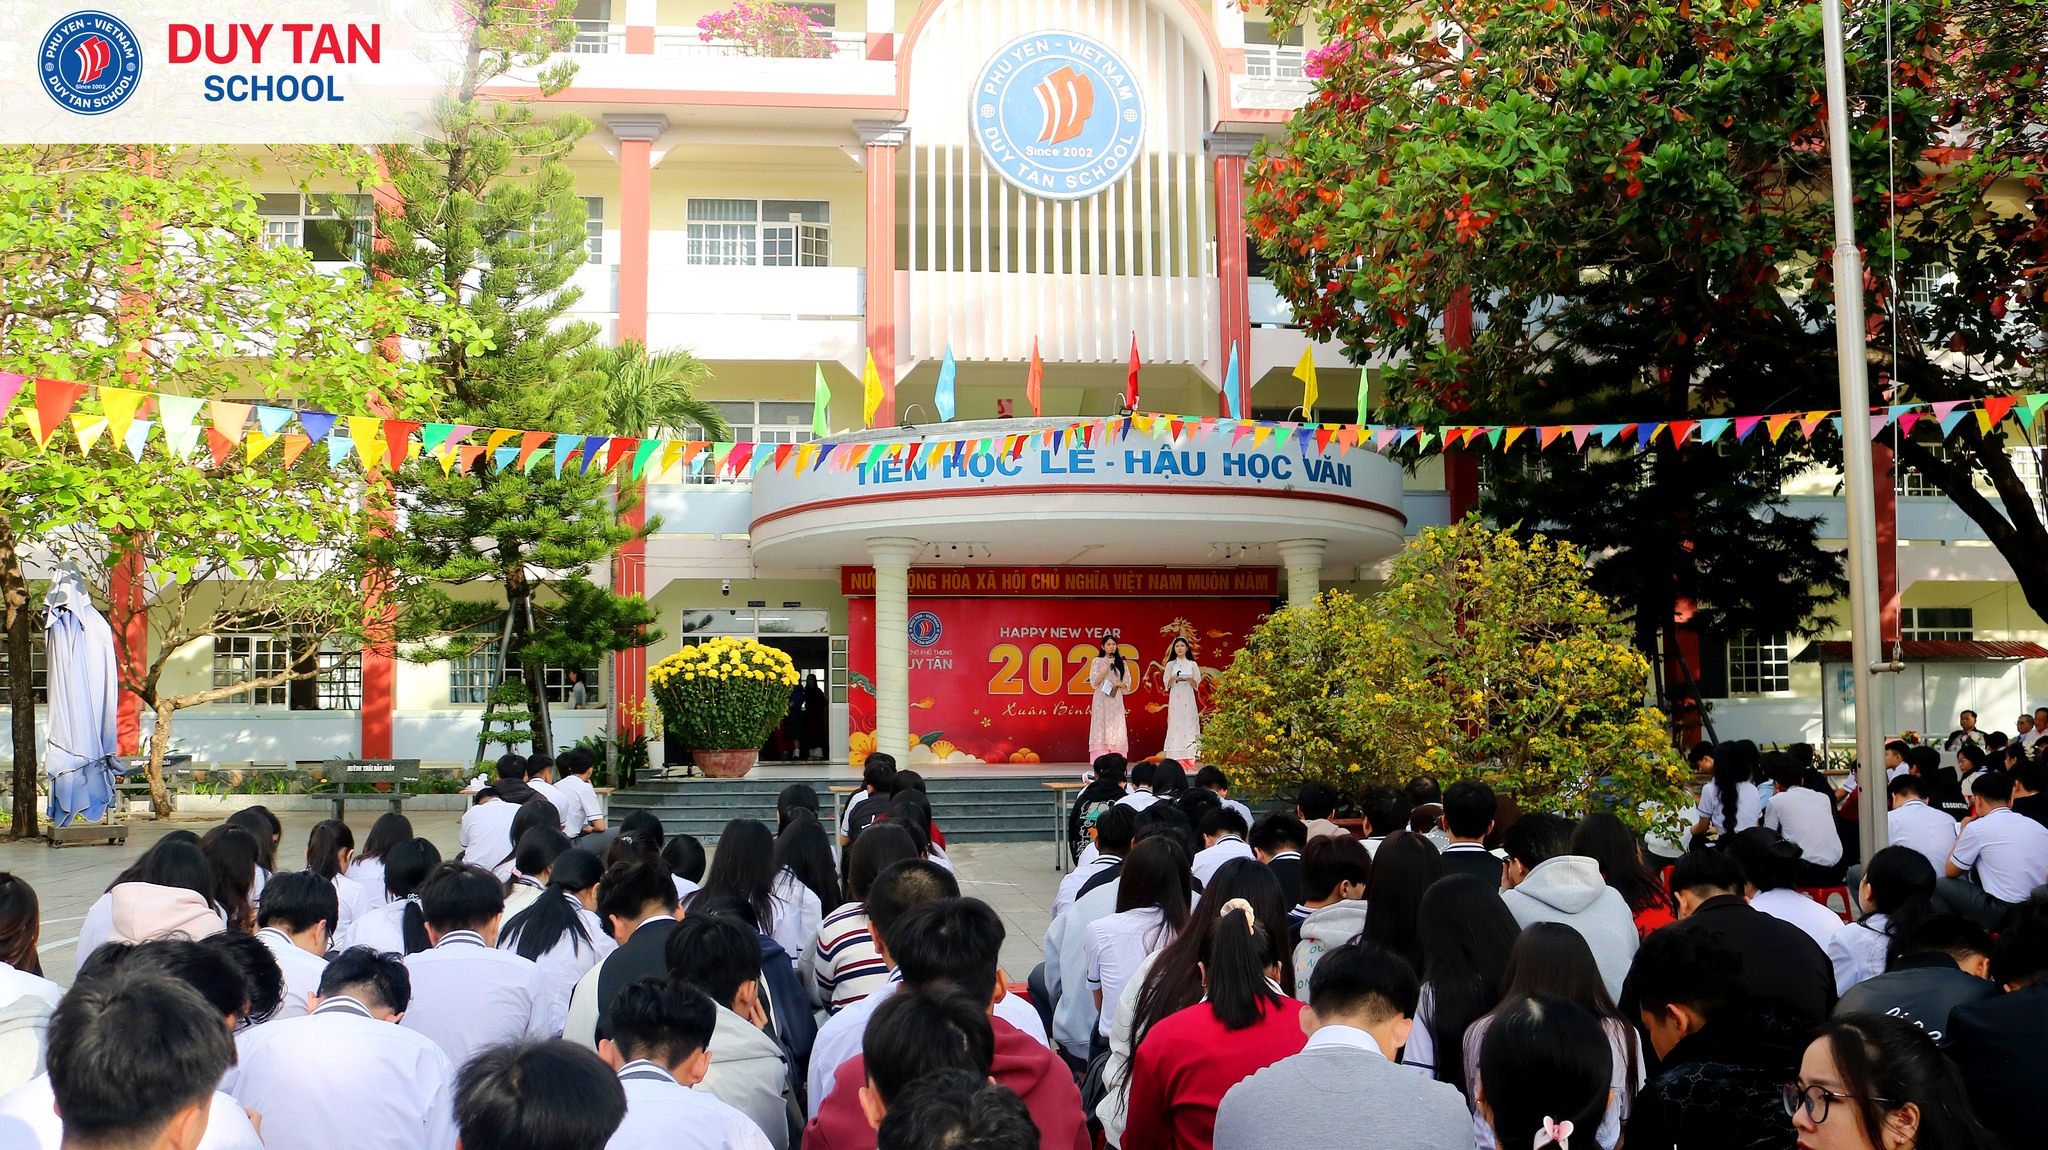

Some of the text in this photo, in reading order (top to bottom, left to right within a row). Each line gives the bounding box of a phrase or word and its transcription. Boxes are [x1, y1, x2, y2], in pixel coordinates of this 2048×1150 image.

[984, 60, 1013, 96] PHU
[1010, 39, 1050, 63] YEN
[984, 126, 1135, 189] DUY TAN SCHOOL
[1025, 145, 1094, 158] Since 2002
[1124, 444, 1206, 480] HẬU
[1223, 452, 1292, 484] HỌC
[1302, 454, 1352, 488] VĂN
[907, 570, 937, 593] ỘNG
[942, 570, 971, 590] HÒA
[976, 570, 997, 590] XÃ
[1002, 569, 1026, 594] HỘI
[1031, 568, 1060, 590] CHỦ
[1065, 569, 1109, 590] NGHĨA
[1113, 570, 1144, 593] VIỆT
[1149, 574, 1183, 590] NAM
[1187, 570, 1230, 590] MUÔN
[1234, 570, 1269, 590] NĂM
[1000, 627, 1121, 638] HAPPY NEW YEAR
[908, 656, 953, 670] UY TÂN
